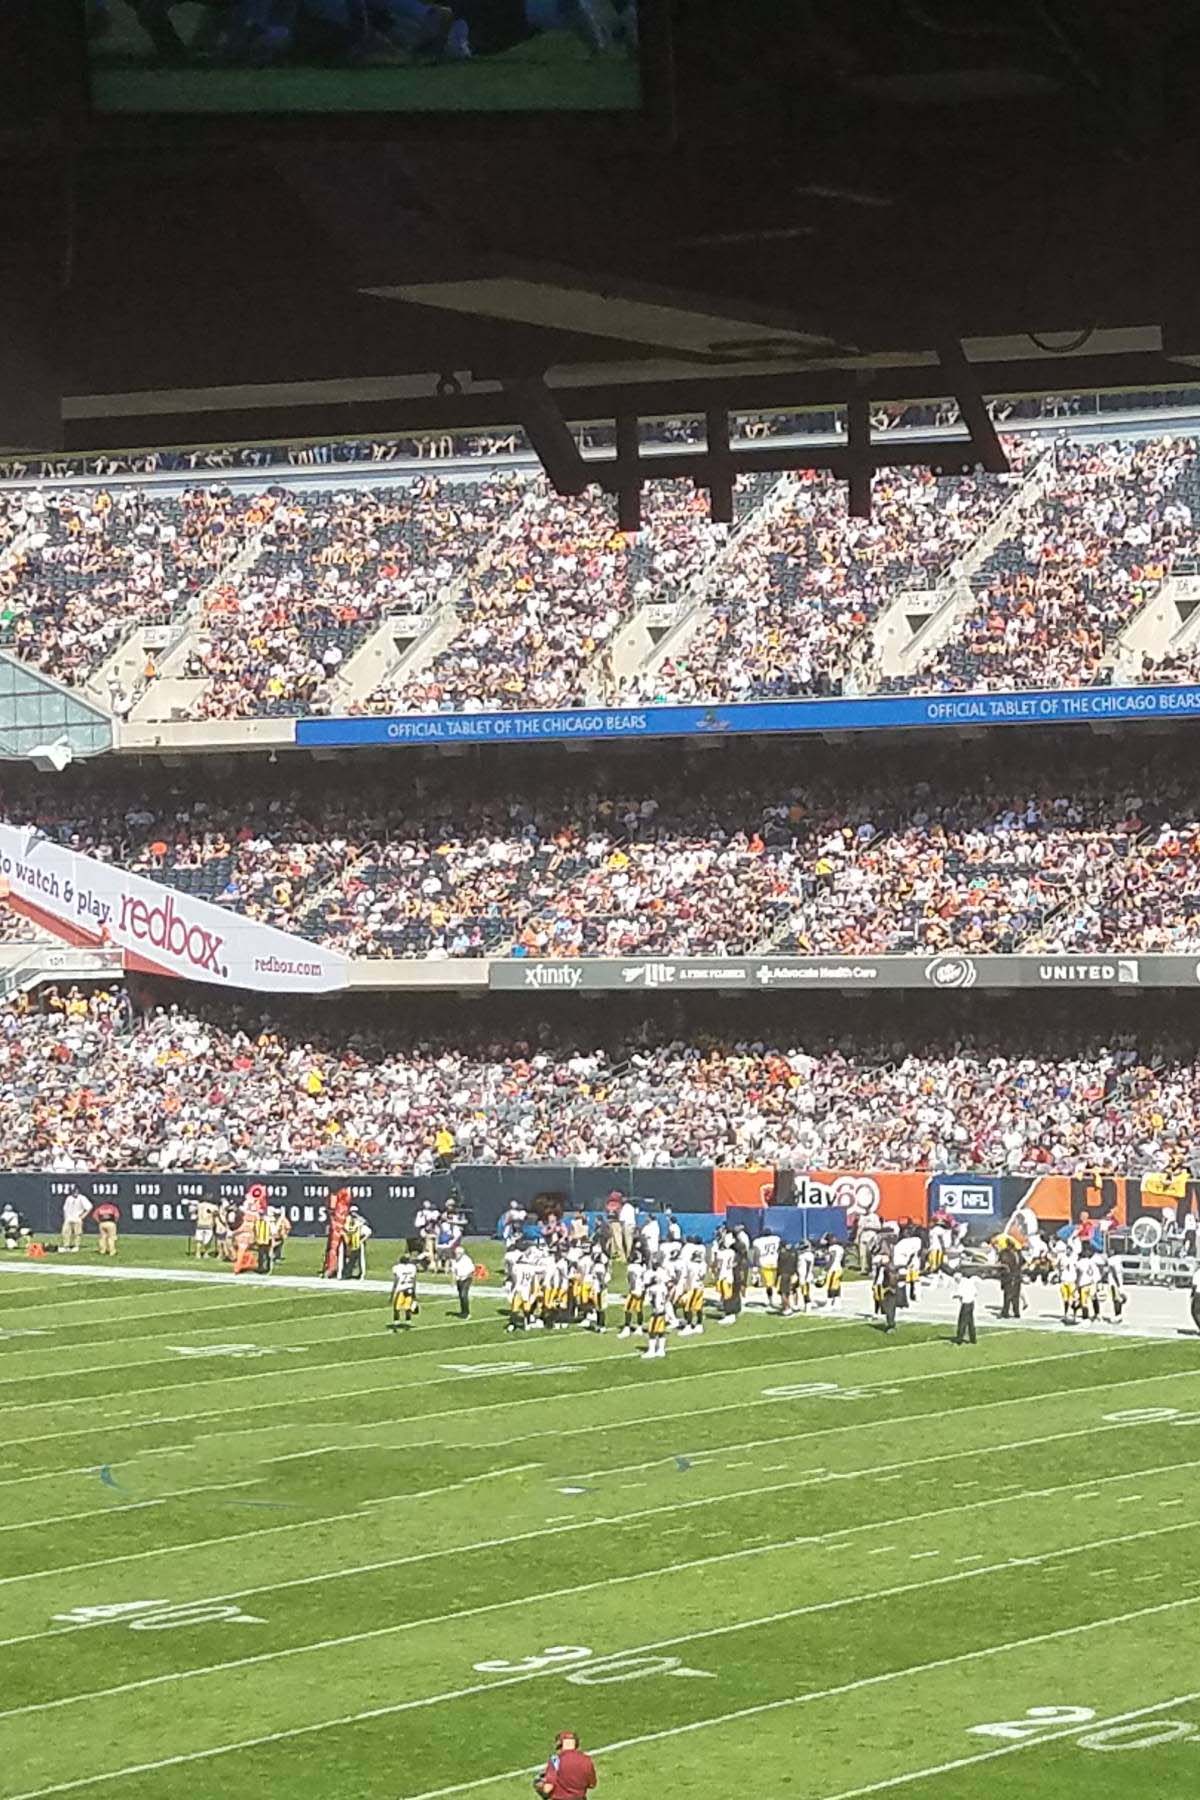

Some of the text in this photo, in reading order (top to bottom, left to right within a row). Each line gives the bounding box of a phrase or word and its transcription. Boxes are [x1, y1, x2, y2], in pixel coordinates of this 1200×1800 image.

[927, 702, 987, 718] OFFICIAL
[989, 700, 1036, 716] TABLET
[1039, 700, 1059, 715] OF
[1060, 698, 1089, 714] THE
[1091, 695, 1157, 712] CHICAGO
[387, 714, 647, 738] OFFICIAL TABLET OF THE CHICAGO BEARS
[16, 862, 60, 899] watch
[63, 880, 74, 903] &
[77, 890, 113, 925] play.
[254, 955, 322, 977] redbox.com
[1039, 964, 1115, 980] UNITED
[267, 1186, 288, 1197] 943
[963, 1191, 989, 1208] NFL
[965, 1705, 1199, 1751] 20
